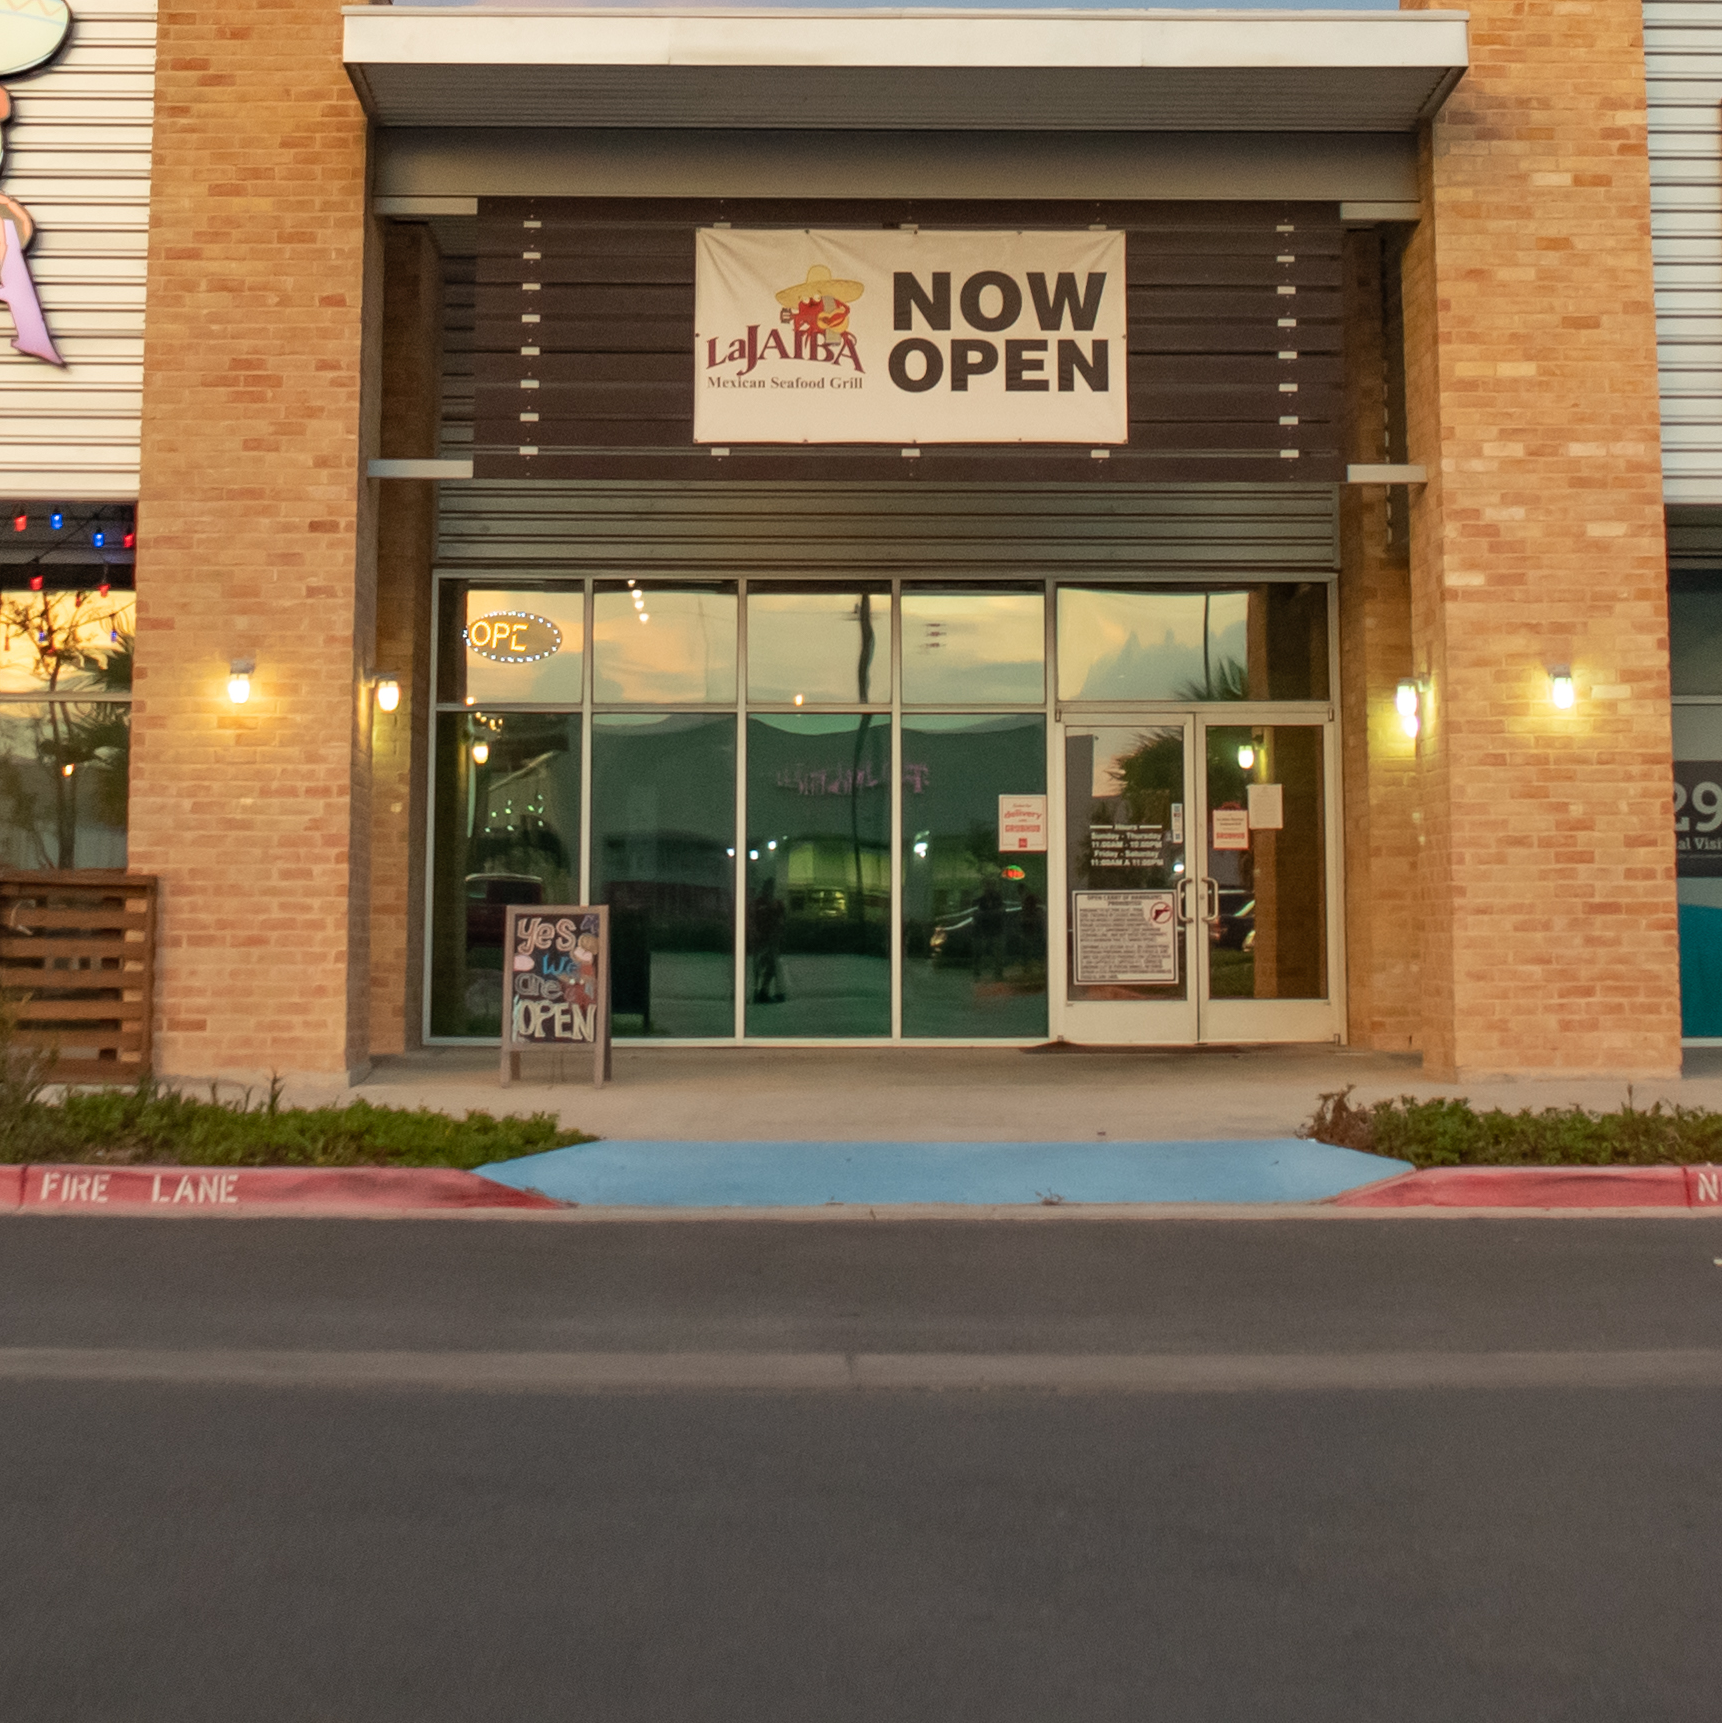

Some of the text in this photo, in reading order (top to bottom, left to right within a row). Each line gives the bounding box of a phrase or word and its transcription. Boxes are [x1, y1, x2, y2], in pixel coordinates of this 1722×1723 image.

[892, 270, 1108, 333] NOW
[707, 376, 864, 390] Mexican Seafood Grill
[887, 337, 1110, 394] OPEN
[514, 973, 563, 1000] are
[517, 999, 597, 1043] OPEN
[40, 1171, 239, 1204] FIRE LANE
